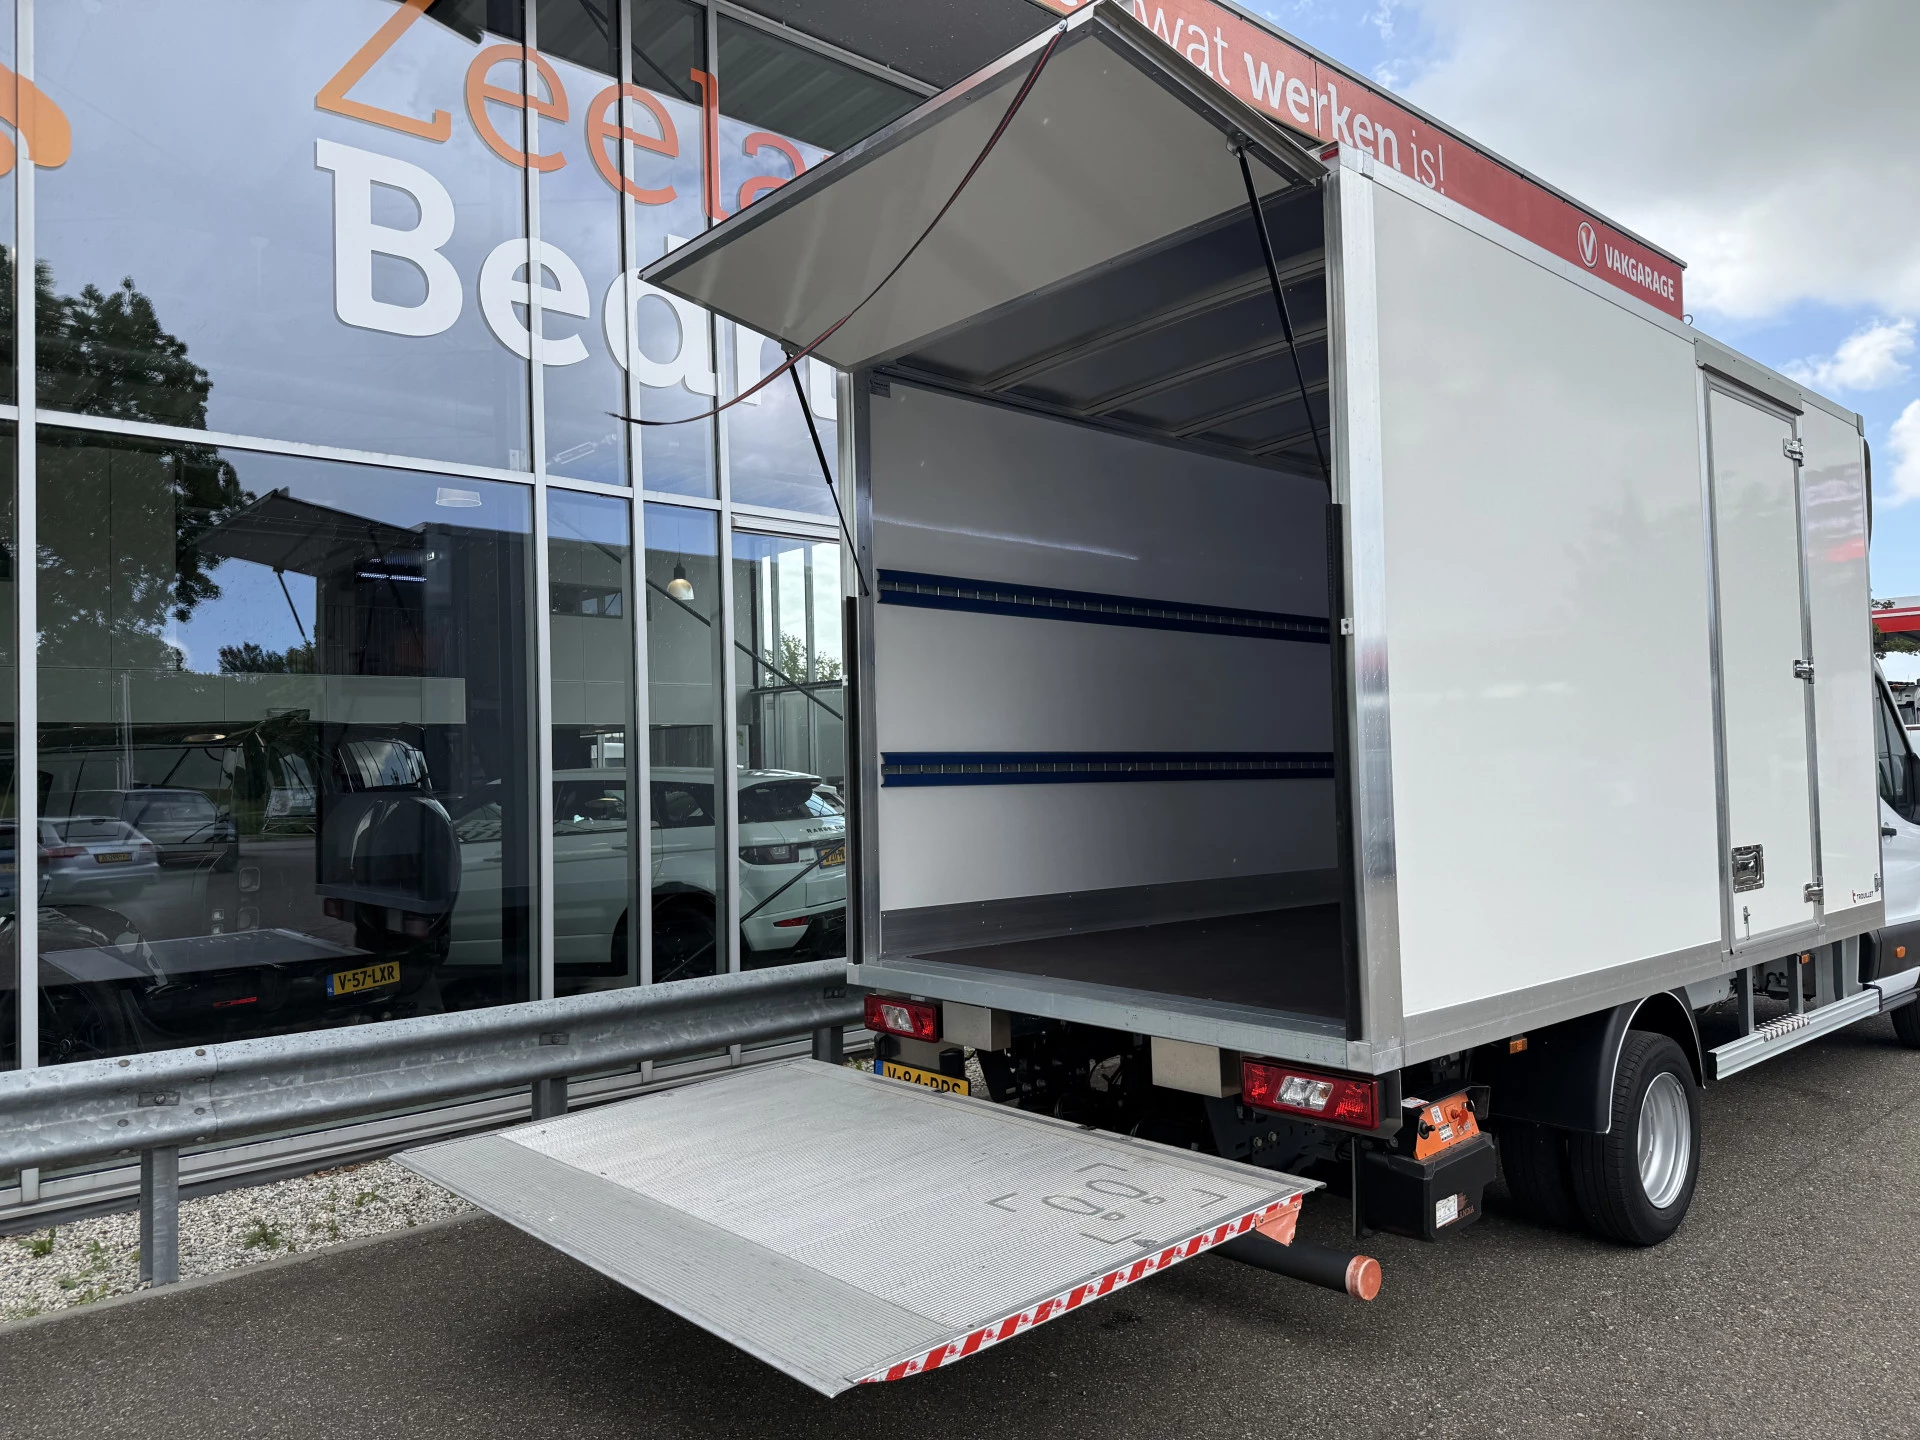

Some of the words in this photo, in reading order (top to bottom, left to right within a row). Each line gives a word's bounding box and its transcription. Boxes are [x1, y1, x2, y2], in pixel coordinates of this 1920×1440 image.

[316, 0, 836, 222] Zeela
[1133, 0, 1230, 86] wat
[1243, 51, 1401, 173] werken
[1410, 129, 1444, 194] is!
[1604, 243, 1675, 302] VAKGARAGE
[338, 965, 395, 991] V-57-LXR
